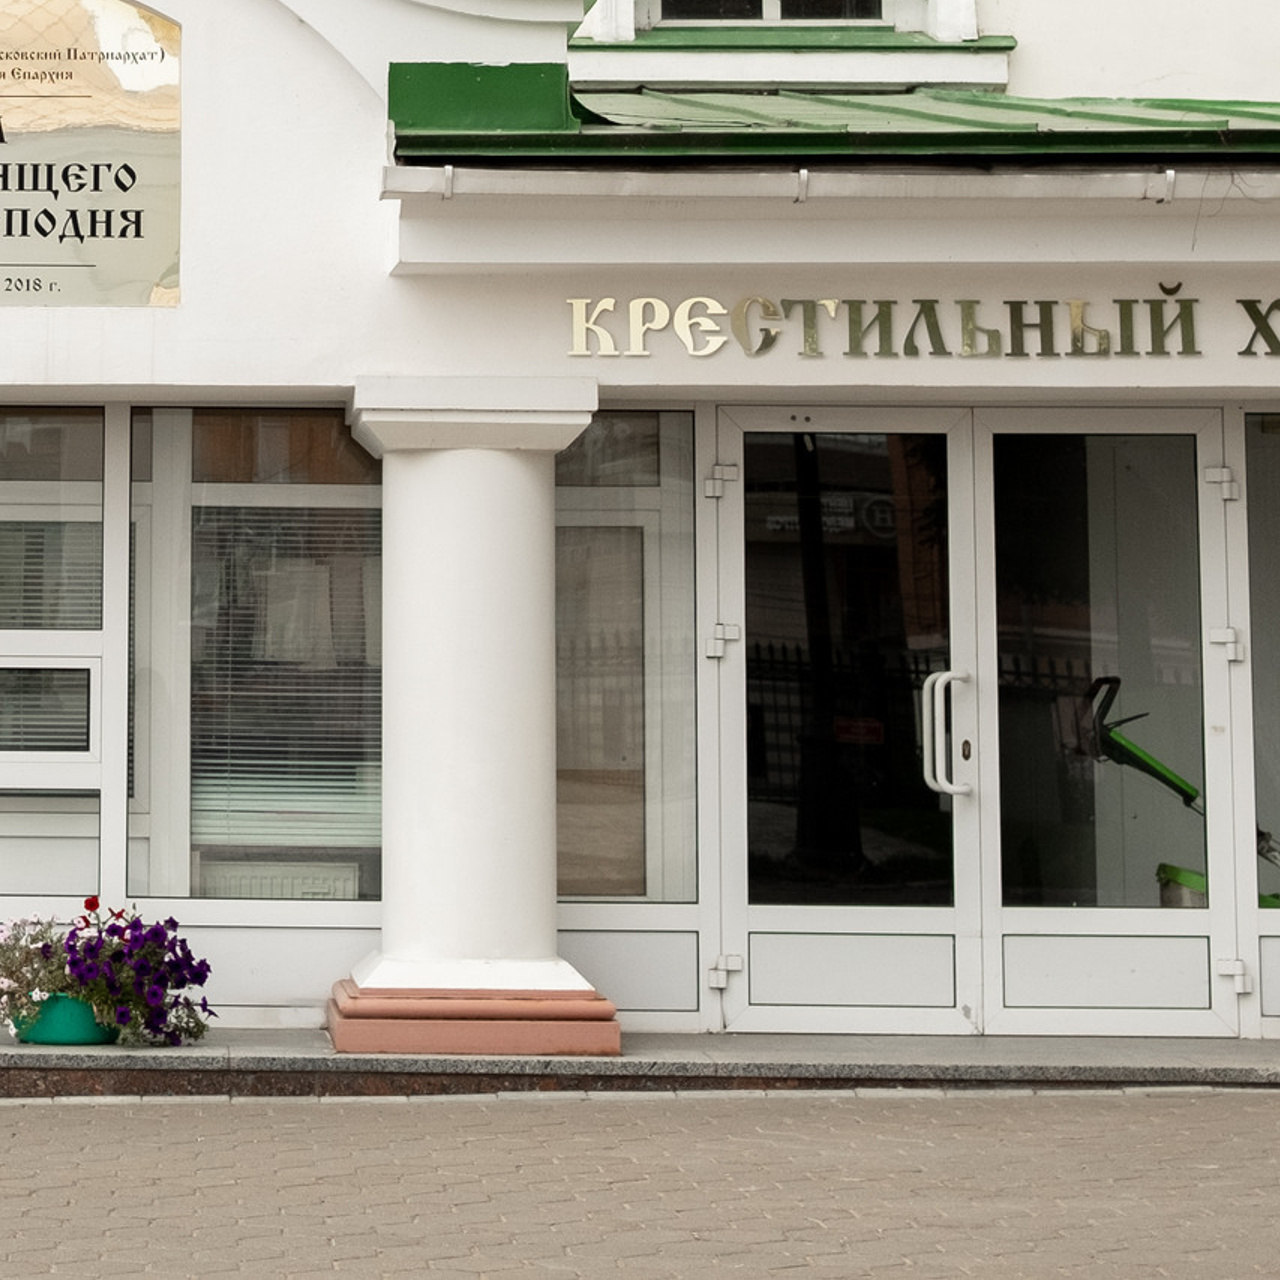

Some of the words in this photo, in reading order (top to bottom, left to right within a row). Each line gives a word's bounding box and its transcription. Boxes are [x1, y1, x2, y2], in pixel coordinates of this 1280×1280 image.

[66, 47, 166, 65] Патриархат)
[3, 277, 44, 292] 2018
[48, 280, 62, 293] г.
[566, 282, 1203, 358] КРЕСТИЛЬНЫЙ
